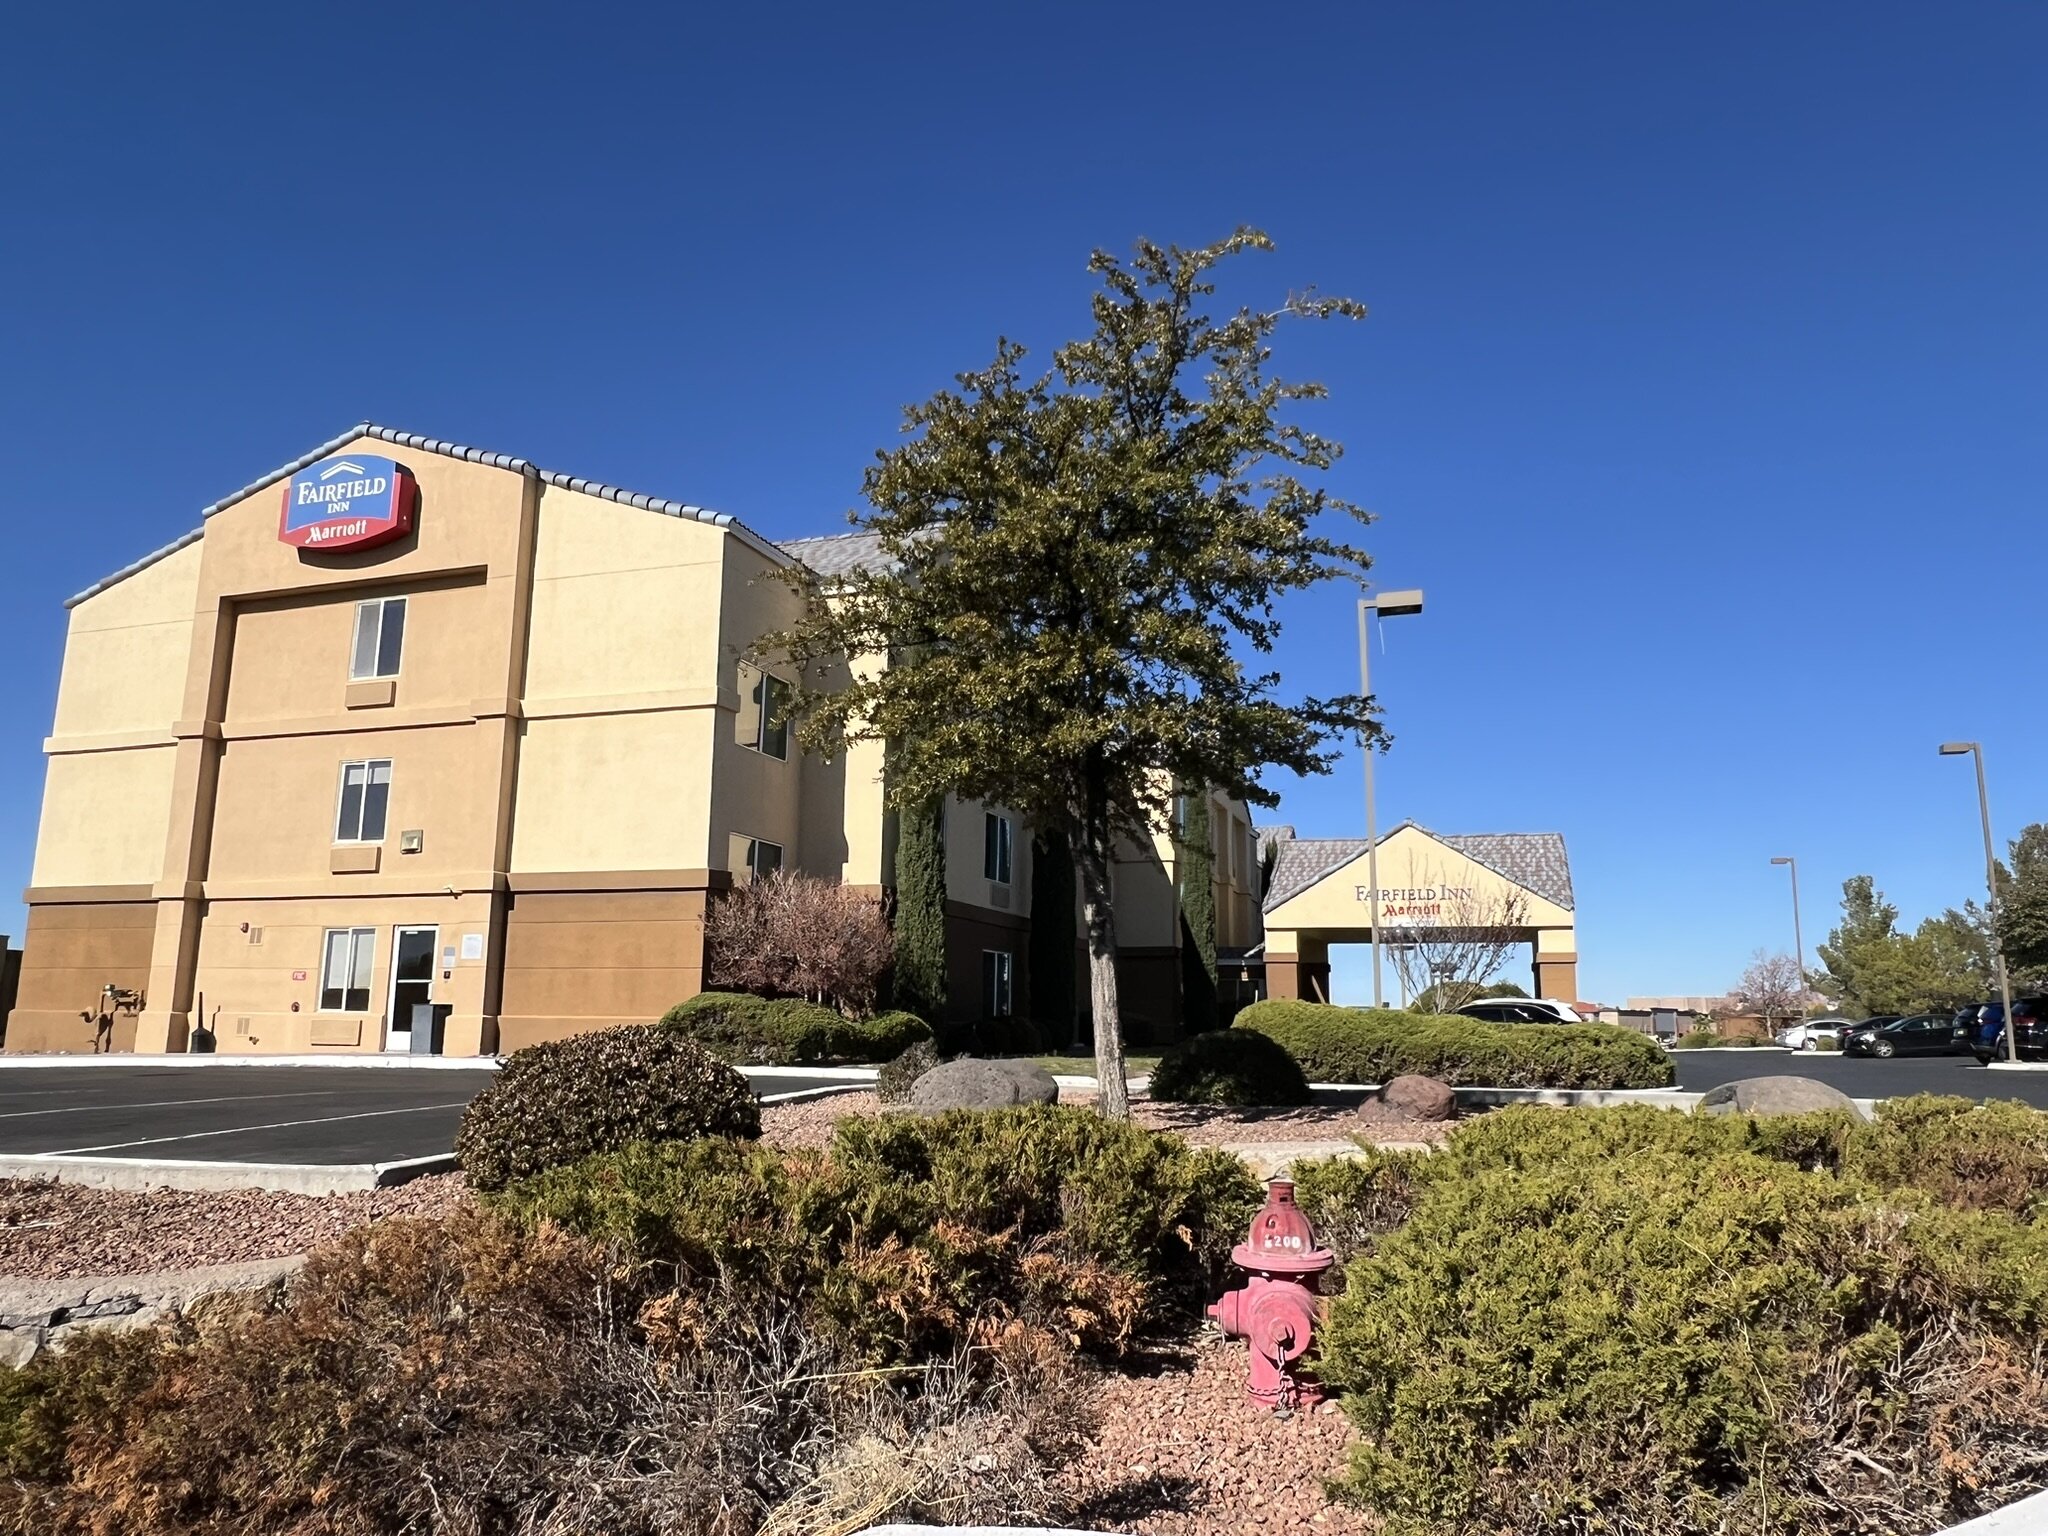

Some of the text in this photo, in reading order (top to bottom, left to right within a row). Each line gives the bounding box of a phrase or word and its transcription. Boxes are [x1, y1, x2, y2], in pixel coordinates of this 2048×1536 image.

[297, 477, 386, 505] FAIRFIELD
[327, 501, 350, 514] INN
[305, 519, 367, 544] Marriott
[1439, 884, 1472, 900] INN
[1382, 903, 1441, 917] Marriott
